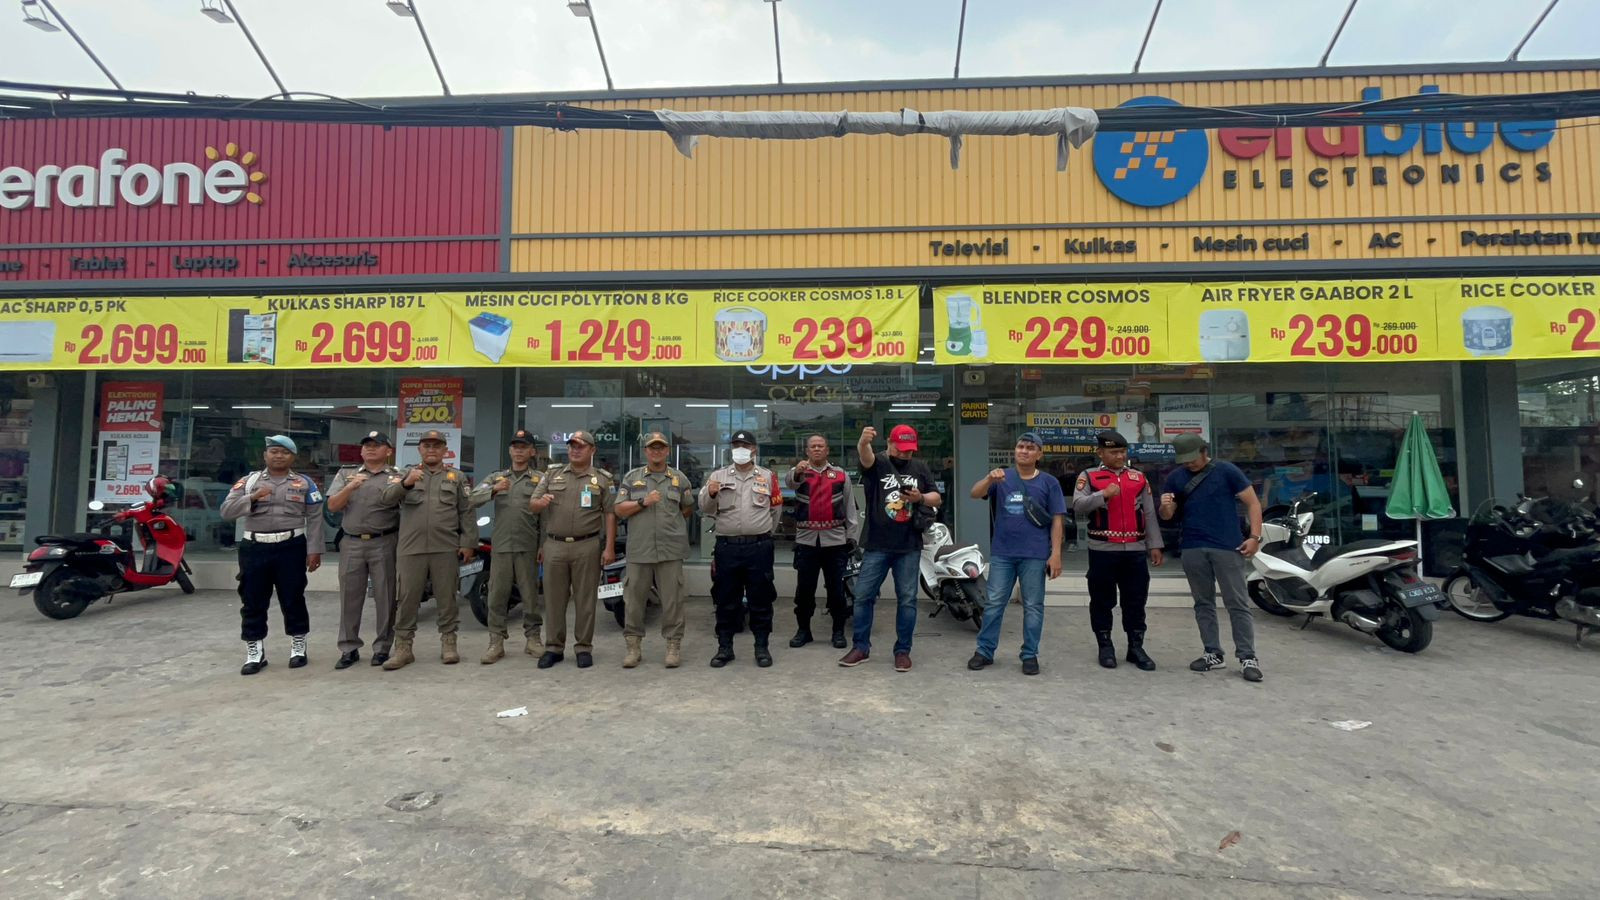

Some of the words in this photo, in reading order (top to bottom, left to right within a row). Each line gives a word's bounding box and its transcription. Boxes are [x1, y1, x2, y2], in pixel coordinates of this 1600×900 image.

[0, 148, 248, 209] erafone
[1223, 162, 1552, 190] ELECTRONICS
[930, 238, 1009, 256] Televisi
[1064, 235, 1136, 254] Kulkas
[1193, 234, 1257, 253] Mesin
[1262, 233, 1309, 251] cuci
[1369, 232, 1401, 249] AC
[1461, 229, 1572, 247] Peralatan
[69, 256, 126, 271] Tablet
[172, 255, 238, 271] Laptop
[287, 251, 377, 268] Aksesoris
[713, 291, 744, 303] RICE
[747, 290, 806, 302] COOKER
[809, 288, 873, 301] COSMOS
[876, 288, 894, 300] 1.8
[898, 288, 904, 299] L
[1201, 288, 1233, 302] AIR
[1237, 287, 1295, 301] FRYER
[1300, 286, 1384, 301] GAABOR
[1388, 285, 1399, 299] 2
[1404, 285, 1413, 299] L
[1461, 284, 1505, 298] RICE
[1510, 282, 1595, 297] COOKER
[465, 294, 514, 307] MESIN
[518, 294, 558, 306] CUCI
[561, 293, 648, 306] POLYTRON
[651, 293, 661, 305] 8
[665, 292, 689, 305] KG
[983, 290, 1062, 304] BLENDER
[1067, 289, 1150, 304] COSMOS
[1, 302, 22, 313] AC
[25, 300, 76, 313] SHARP
[79, 300, 104, 314] 0,5
[106, 300, 127, 312] PK
[268, 298, 330, 310] KULKAS
[334, 296, 387, 309] SHARP
[389, 296, 414, 308] 187
[418, 296, 425, 308] L
[1271, 328, 1286, 340] Rp
[1550, 322, 1566, 335] Rp
[1568, 308, 1600, 351] 2
[778, 334, 792, 345] Rp
[1009, 330, 1023, 342] Rp
[64, 342, 76, 353] Rp
[295, 340, 308, 351] Rp
[527, 337, 540, 349] Rp
[108, 400, 156, 411] PALING
[961, 402, 988, 410] PARKIR
[106, 411, 155, 423] HEMAT
[961, 410, 988, 418] GRATIS
[1034, 417, 1060, 425] BIAYA
[1063, 417, 1095, 425] ADMIN
[596, 433, 619, 441] TCL
[891, 492, 899, 500] 8
[1303, 535, 1330, 544] SUNG
